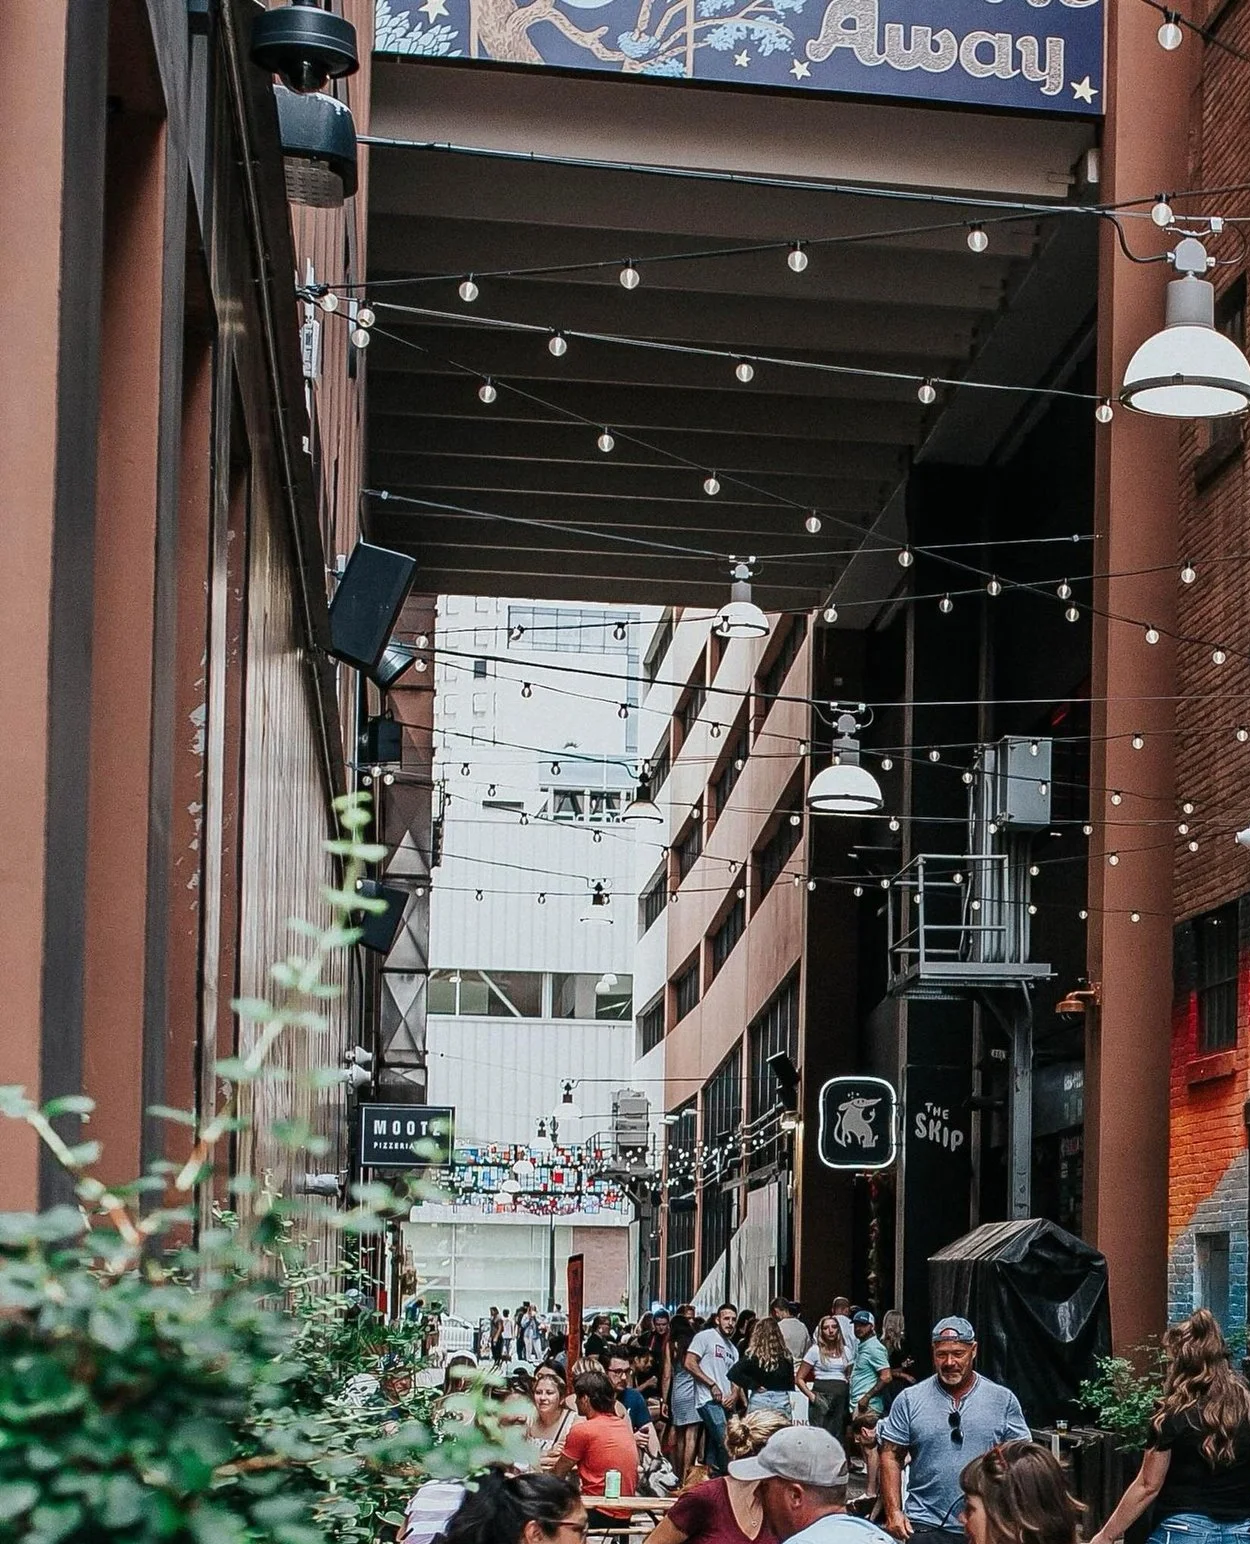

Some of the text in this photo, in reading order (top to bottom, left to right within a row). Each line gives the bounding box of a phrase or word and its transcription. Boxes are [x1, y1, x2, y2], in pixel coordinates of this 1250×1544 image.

[805, 0, 1065, 95] Away
[925, 1102, 950, 1119] THE
[373, 1141, 415, 1150] PIZZERIA
[915, 1112, 964, 1152] SKIP
